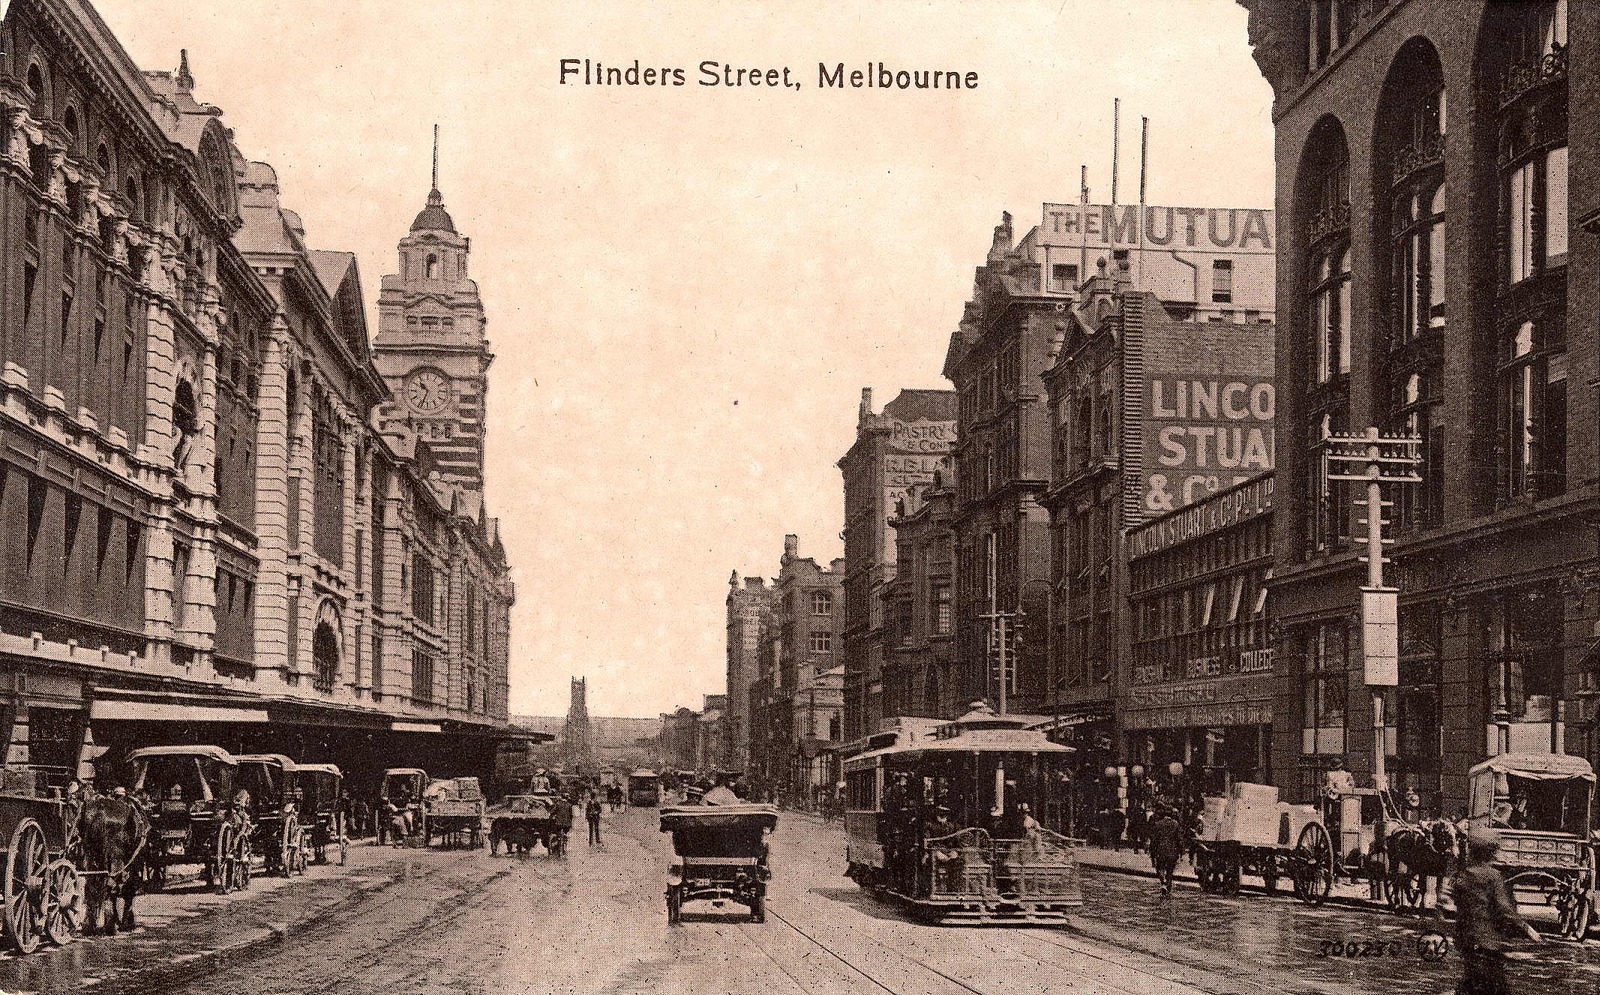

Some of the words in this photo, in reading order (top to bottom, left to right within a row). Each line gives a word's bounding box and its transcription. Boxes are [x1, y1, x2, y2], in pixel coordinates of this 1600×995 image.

[1049, 211, 1099, 234] THE
[1101, 206, 1272, 249] MUTUA
[1152, 380, 1275, 420] LINCO
[893, 421, 945, 440] PASTRY
[1158, 426, 1275, 469] STUA
[1146, 474, 1174, 510] &
[1131, 522, 1165, 559] LINCOLN
[1169, 504, 1206, 545] STUART
[1240, 649, 1274, 673] COLLEGE
